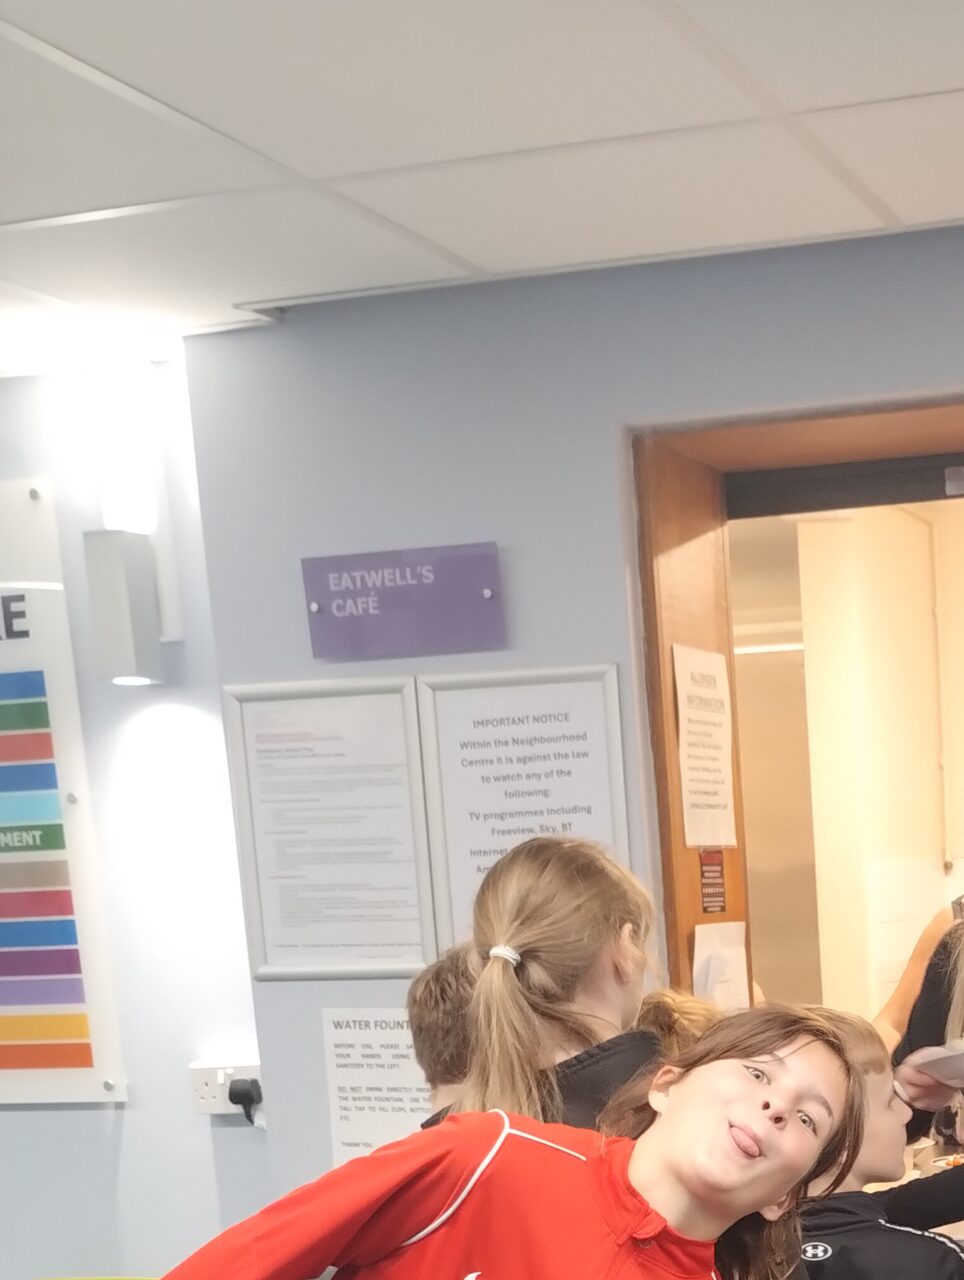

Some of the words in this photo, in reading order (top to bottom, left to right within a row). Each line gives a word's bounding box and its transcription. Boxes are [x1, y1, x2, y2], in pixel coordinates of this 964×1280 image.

[328, 565, 435, 591] EATWELL'S
[331, 591, 380, 618] CAFÉ
[472, 715, 530, 729] IMPORTANT
[532, 712, 571, 724] NOTICE
[459, 738, 492, 750] Within
[494, 737, 510, 748] the
[511, 732, 588, 748] Neighbourhood
[461, 756, 495, 768] Centre
[496, 756, 503, 766] it
[505, 755, 514, 765] is
[516, 753, 552, 767] against
[553, 751, 570, 761] the
[572, 750, 590, 760] law
[481, 774, 491, 784] to
[493, 772, 523, 783] watch
[525, 772, 542, 783] any
[544, 770, 555, 780] of
[556, 768, 573, 778] the
[468, 811, 481, 821] TV
[483, 808, 545, 823] programmes
[547, 804, 593, 817] including
[491, 824, 538, 837] Freeview,
[561, 822, 573, 832] BT
[332, 1019, 371, 1031] WATER
